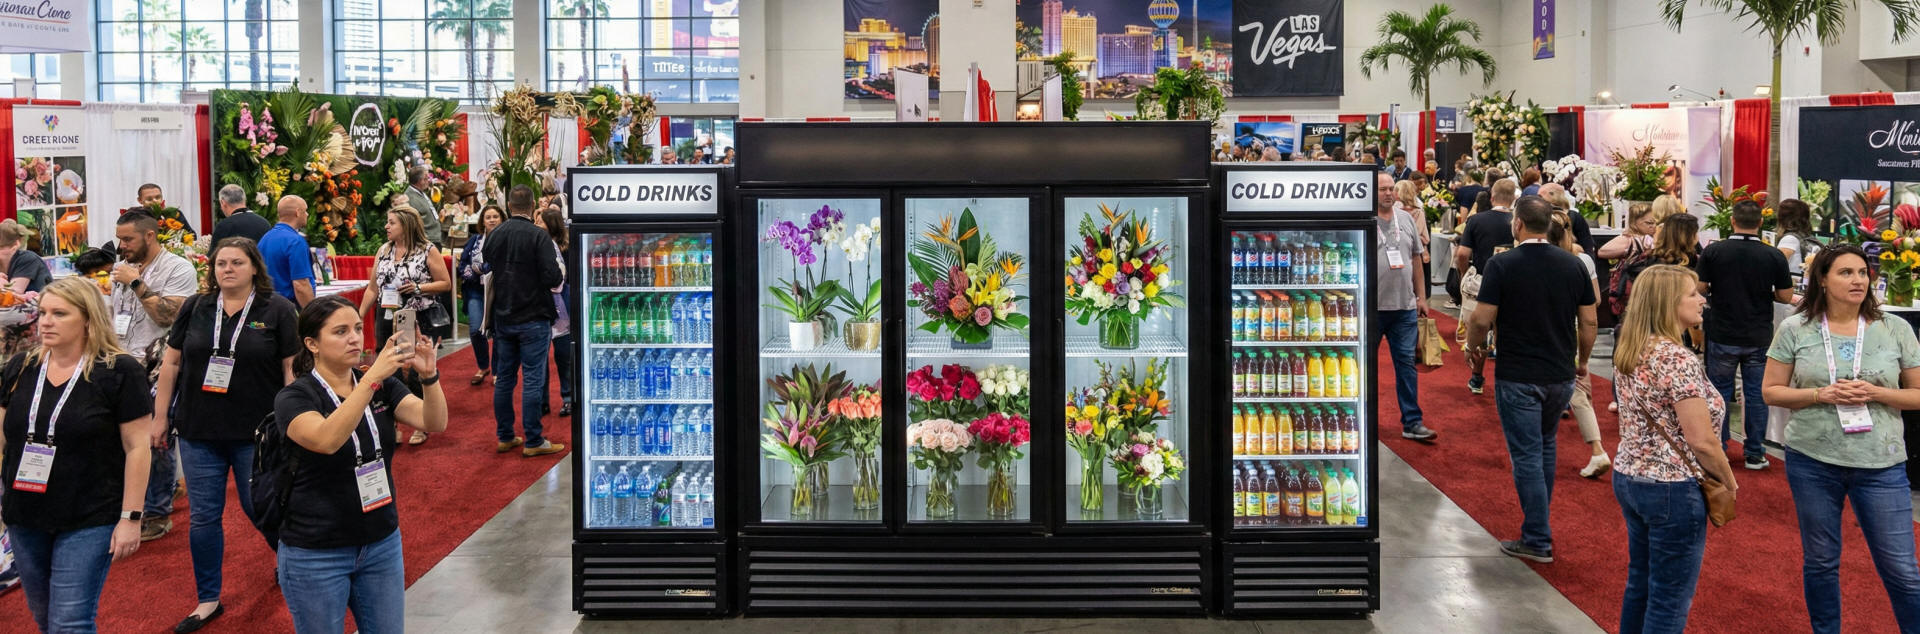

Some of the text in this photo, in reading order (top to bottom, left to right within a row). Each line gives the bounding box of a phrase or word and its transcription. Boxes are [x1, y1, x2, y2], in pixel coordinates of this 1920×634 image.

[1293, 17, 1317, 31] LAS
[1239, 18, 1337, 69] Vegas
[577, 184, 713, 202] COLD DRINKS
[1231, 182, 1368, 200] COLD DRINKS
